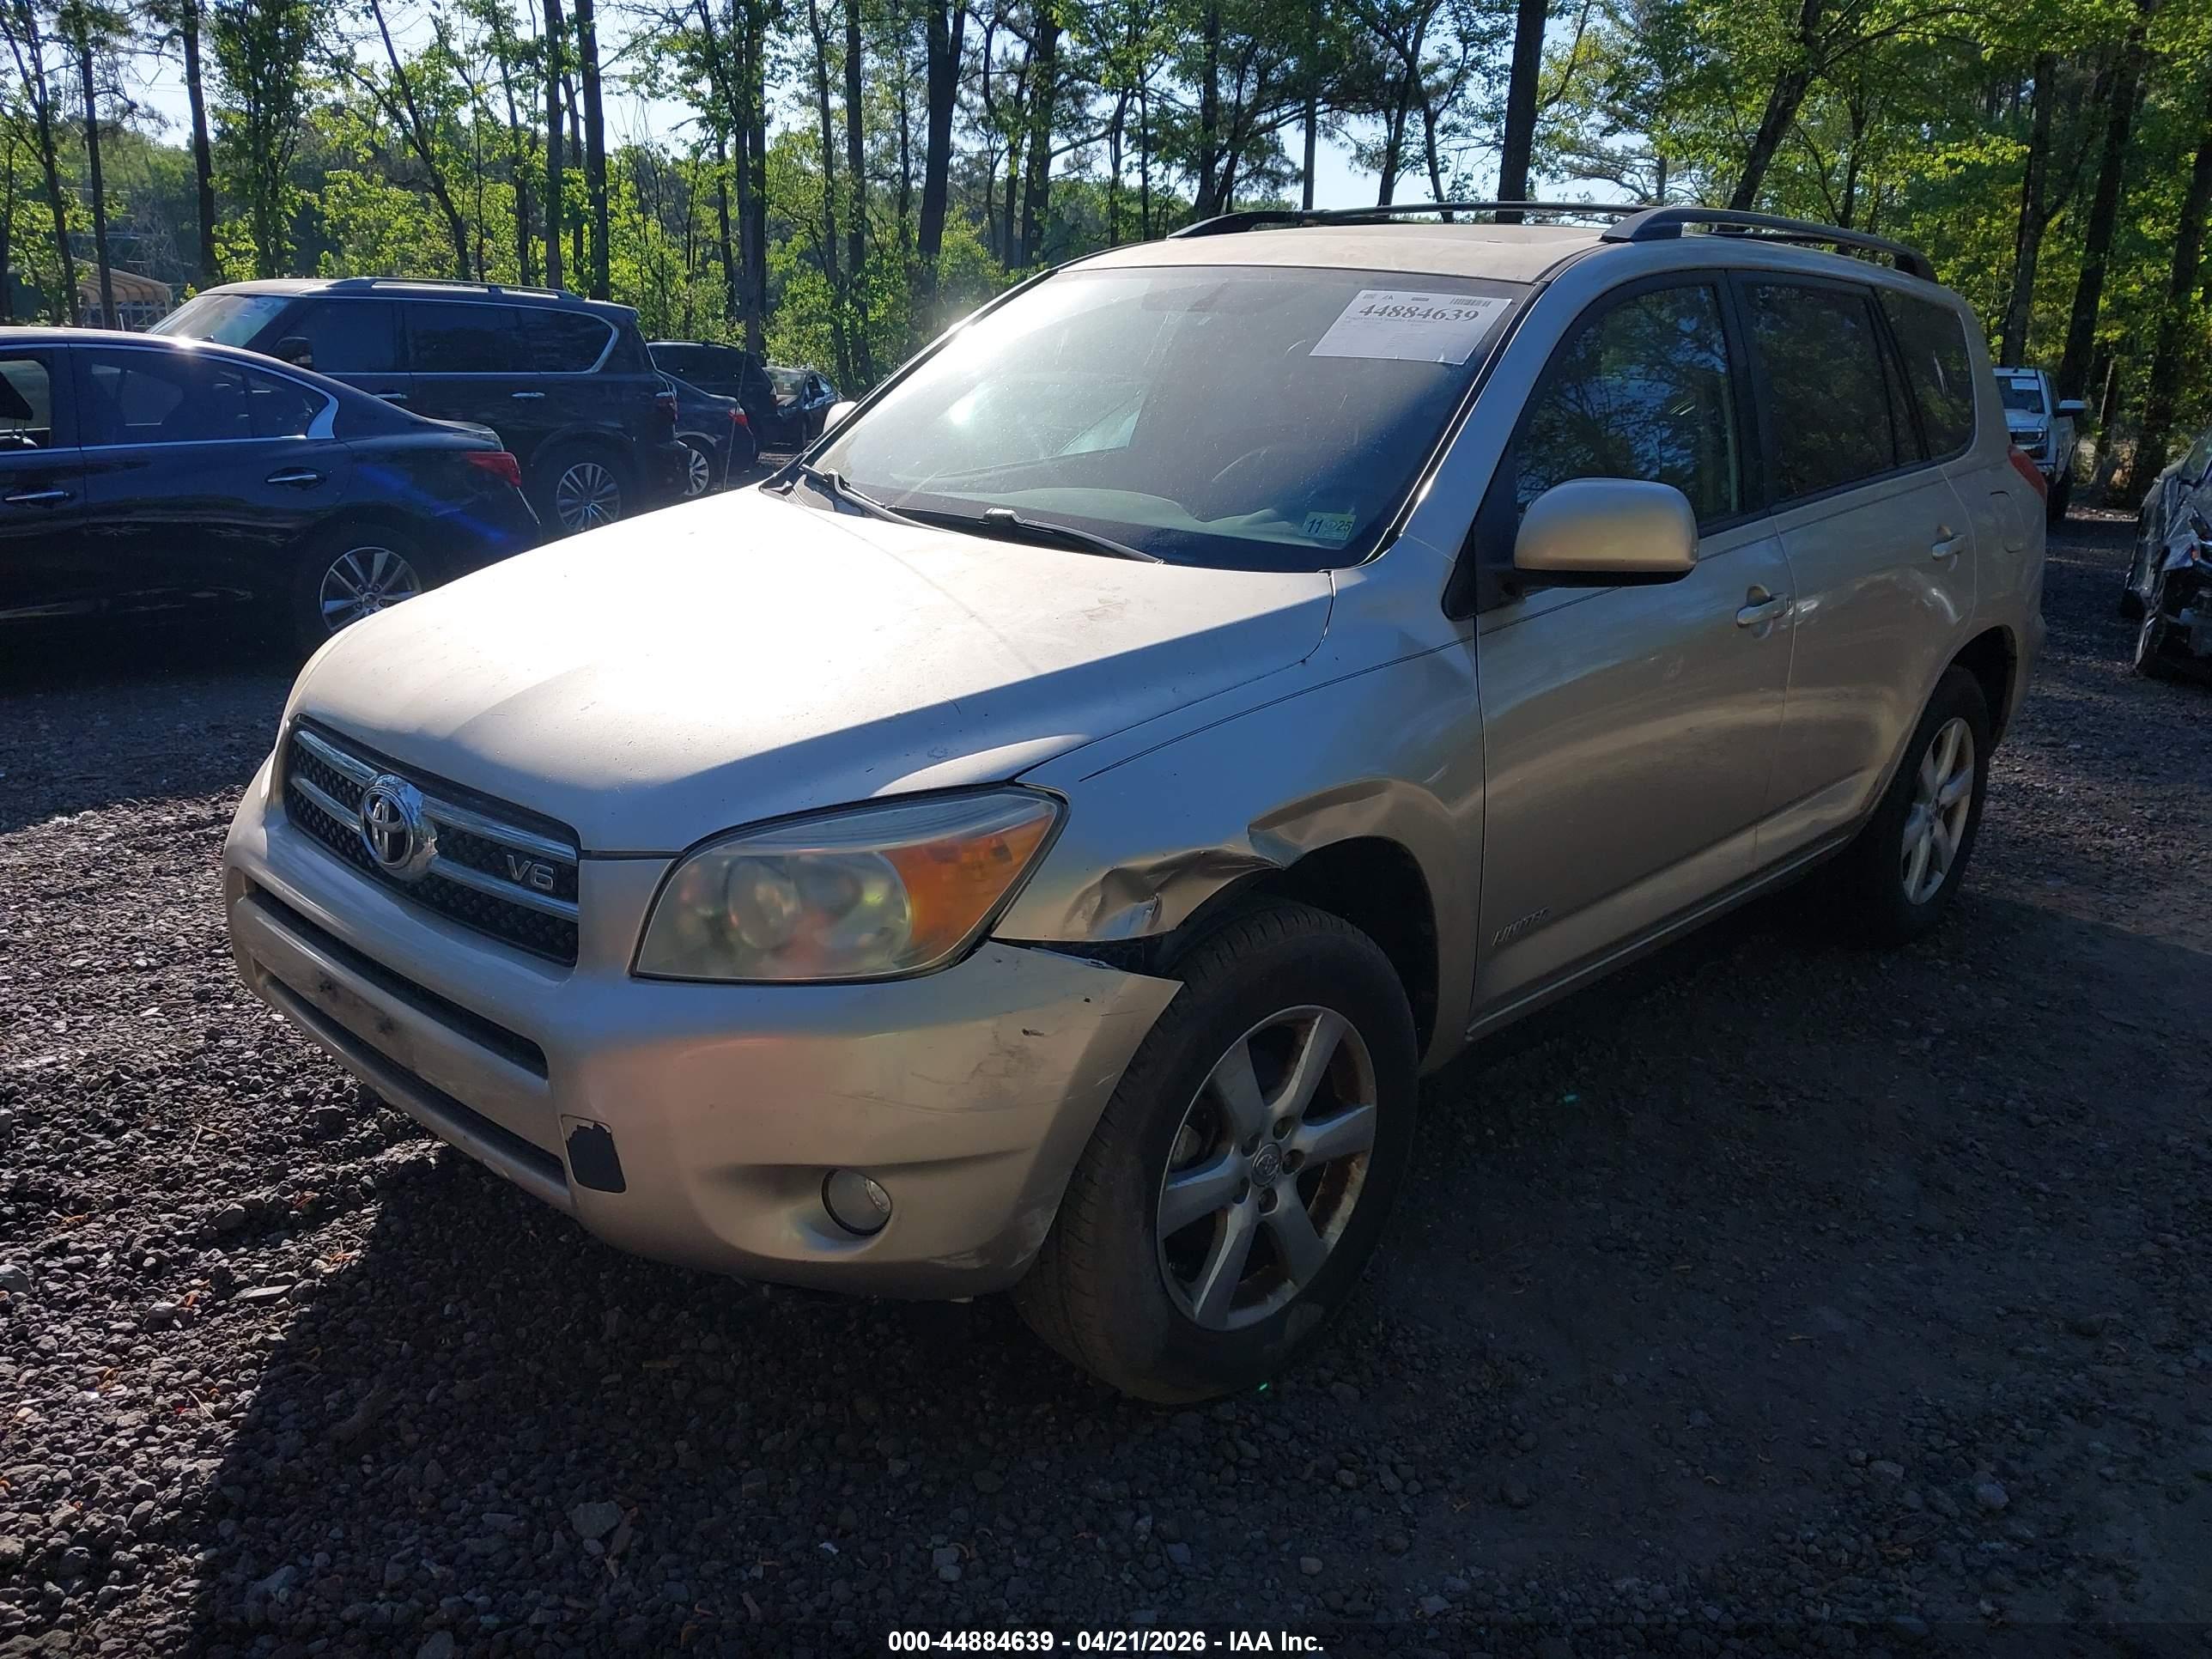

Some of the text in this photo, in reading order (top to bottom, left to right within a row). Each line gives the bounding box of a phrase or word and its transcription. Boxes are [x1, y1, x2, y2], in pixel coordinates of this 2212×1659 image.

[1358, 303, 1480, 323] 44884639
[1307, 518, 1324, 533] 11
[506, 854, 555, 890] V6
